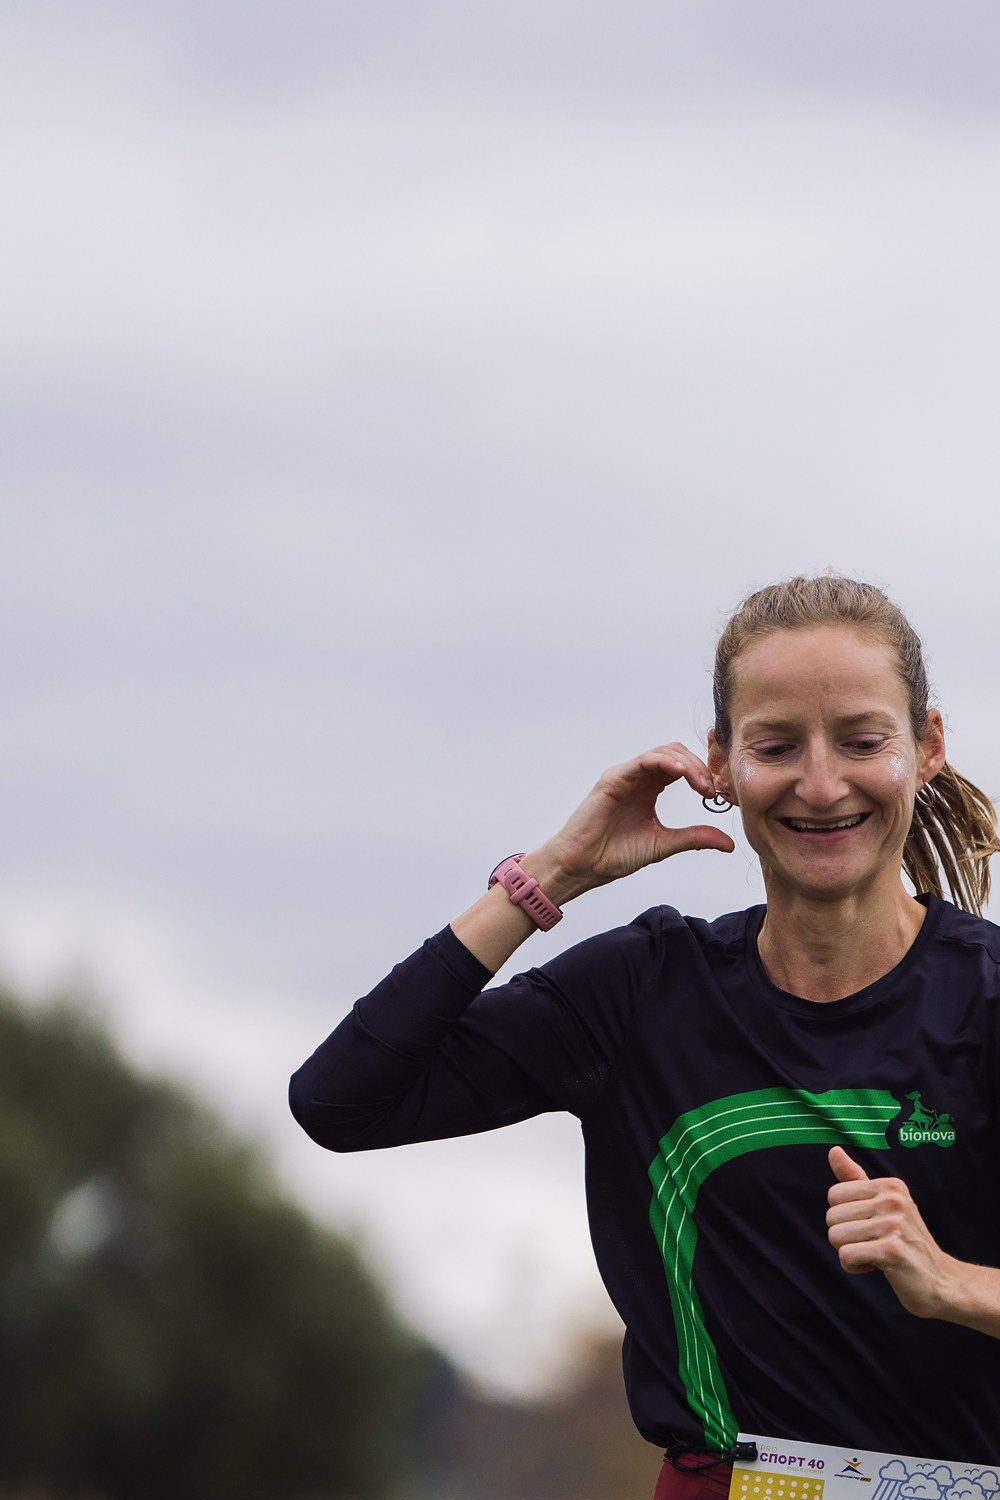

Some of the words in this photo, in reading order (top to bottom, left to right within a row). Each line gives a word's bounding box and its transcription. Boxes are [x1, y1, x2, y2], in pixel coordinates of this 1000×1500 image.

[899, 1127, 955, 1141] bionova
[759, 1452, 806, 1467] СПОРТ
[807, 1459, 825, 1470] 40
